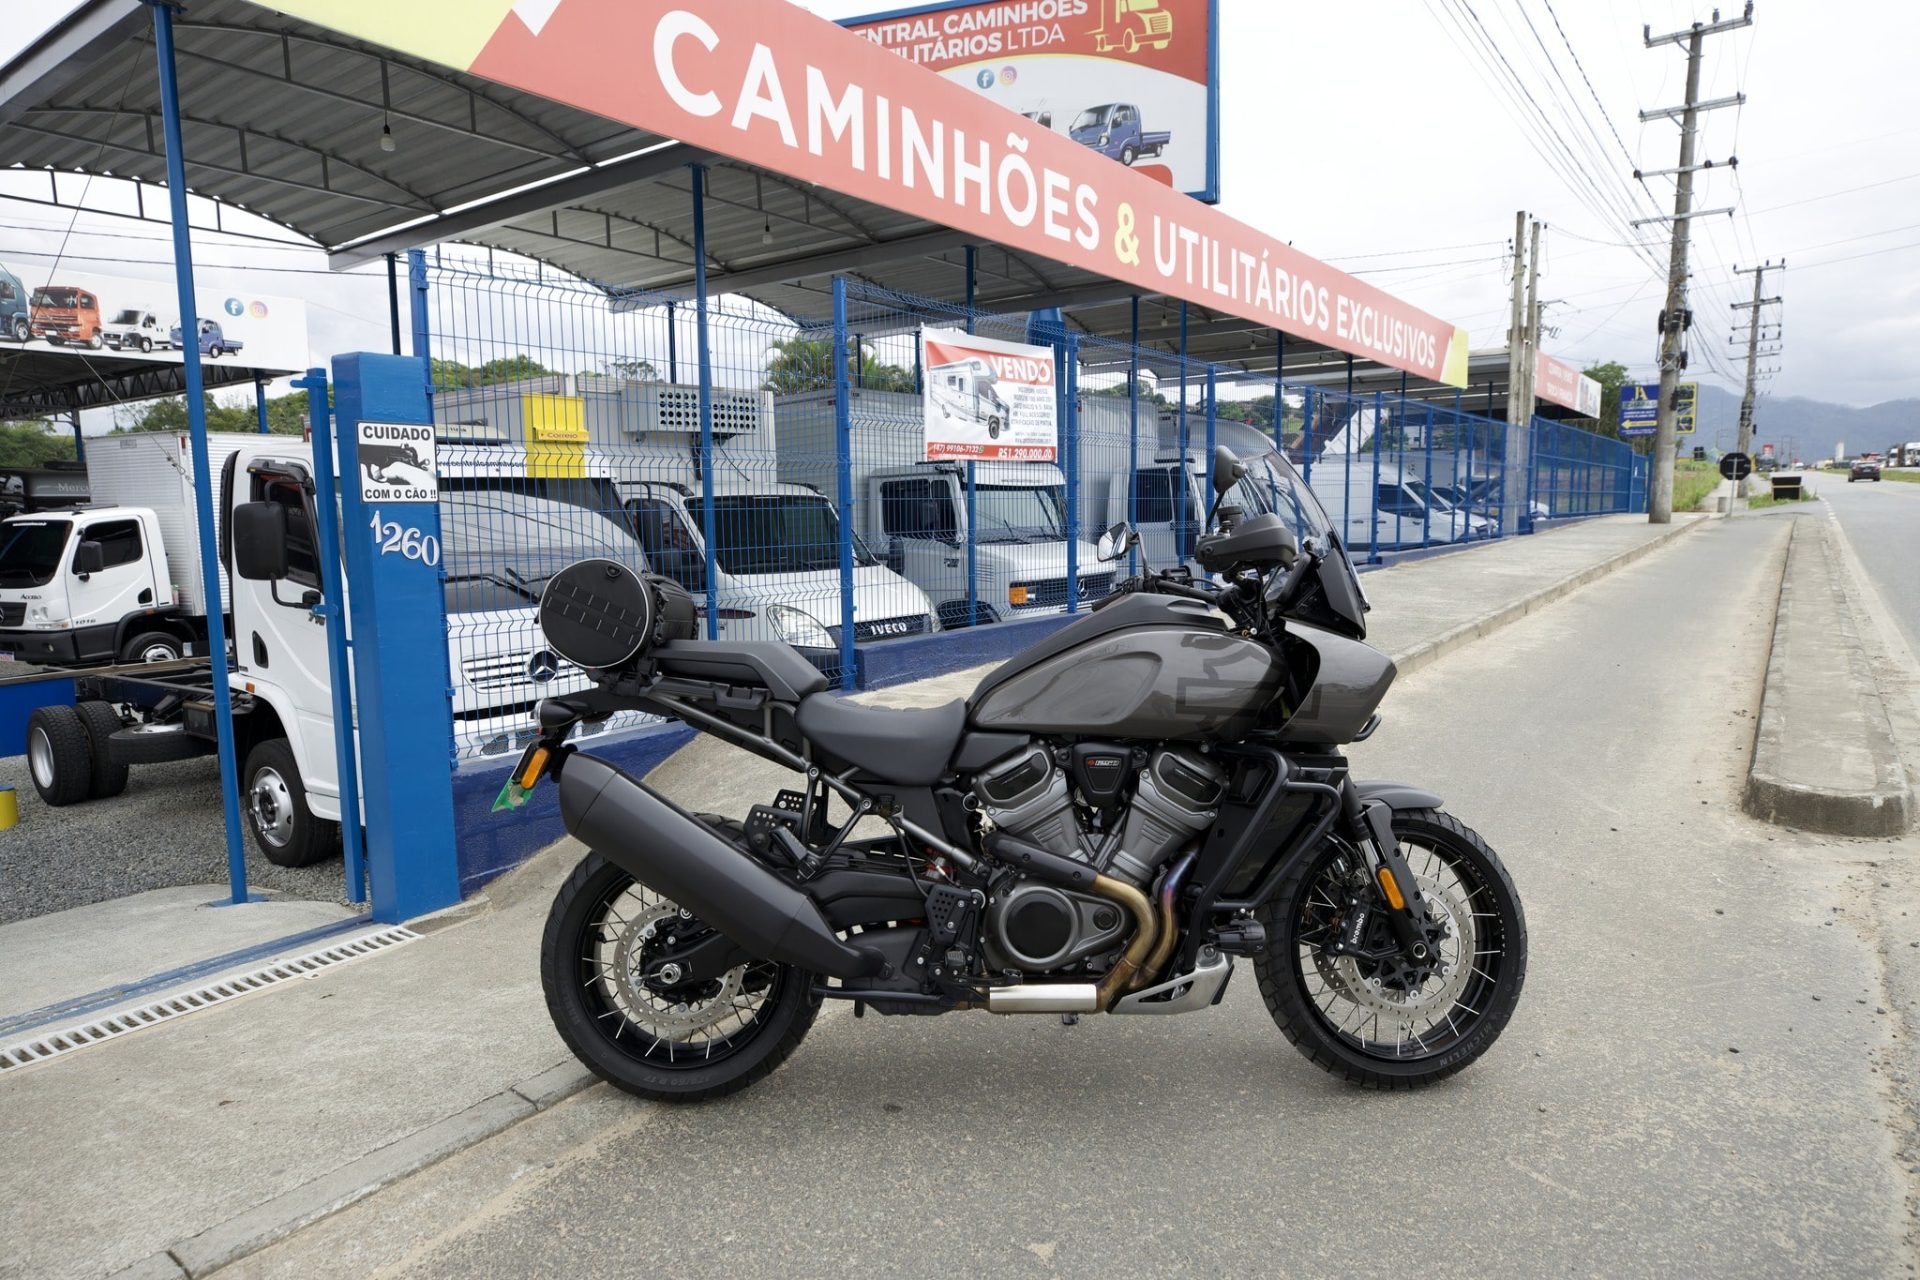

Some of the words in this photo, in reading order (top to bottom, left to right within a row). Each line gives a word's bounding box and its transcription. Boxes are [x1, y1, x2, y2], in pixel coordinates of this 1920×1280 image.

[853, 18, 940, 46] ENTRAL
[1007, 23, 1065, 50] LTDA
[653, 10, 1100, 250] CAMINHÕES
[1114, 202, 1139, 267] &
[1153, 215, 1329, 331] UTILITÁRIOS
[1336, 294, 1435, 369] EXCLUSIVOS
[989, 355, 1051, 383] VENDO
[363, 425, 431, 441] CUIDADO
[365, 489, 391, 499] COM
[393, 489, 402, 499] O
[405, 487, 428, 499] CÃO
[370, 510, 440, 567] 1260
[870, 622, 907, 635] IVECO
[1350, 913, 1365, 944] brembo
[1440, 1021, 1491, 1066] MICHELIN
